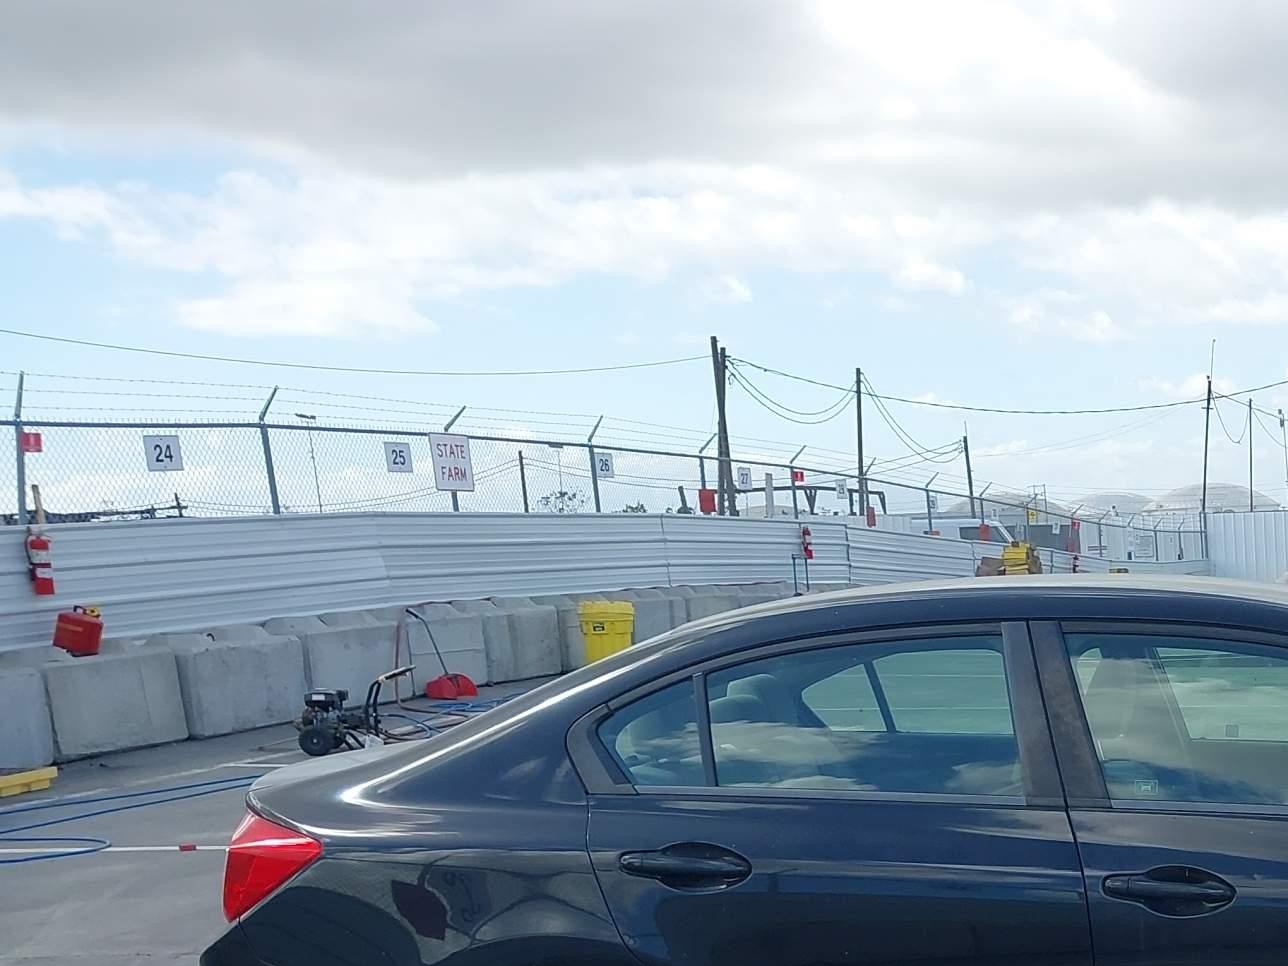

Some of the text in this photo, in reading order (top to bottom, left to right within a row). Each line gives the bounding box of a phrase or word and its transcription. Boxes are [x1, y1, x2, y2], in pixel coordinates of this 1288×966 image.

[153, 444, 173, 463] 24
[391, 449, 406, 465] 25
[436, 443, 466, 459] STATE
[599, 458, 610, 472] 26
[441, 466, 468, 481] FARM
